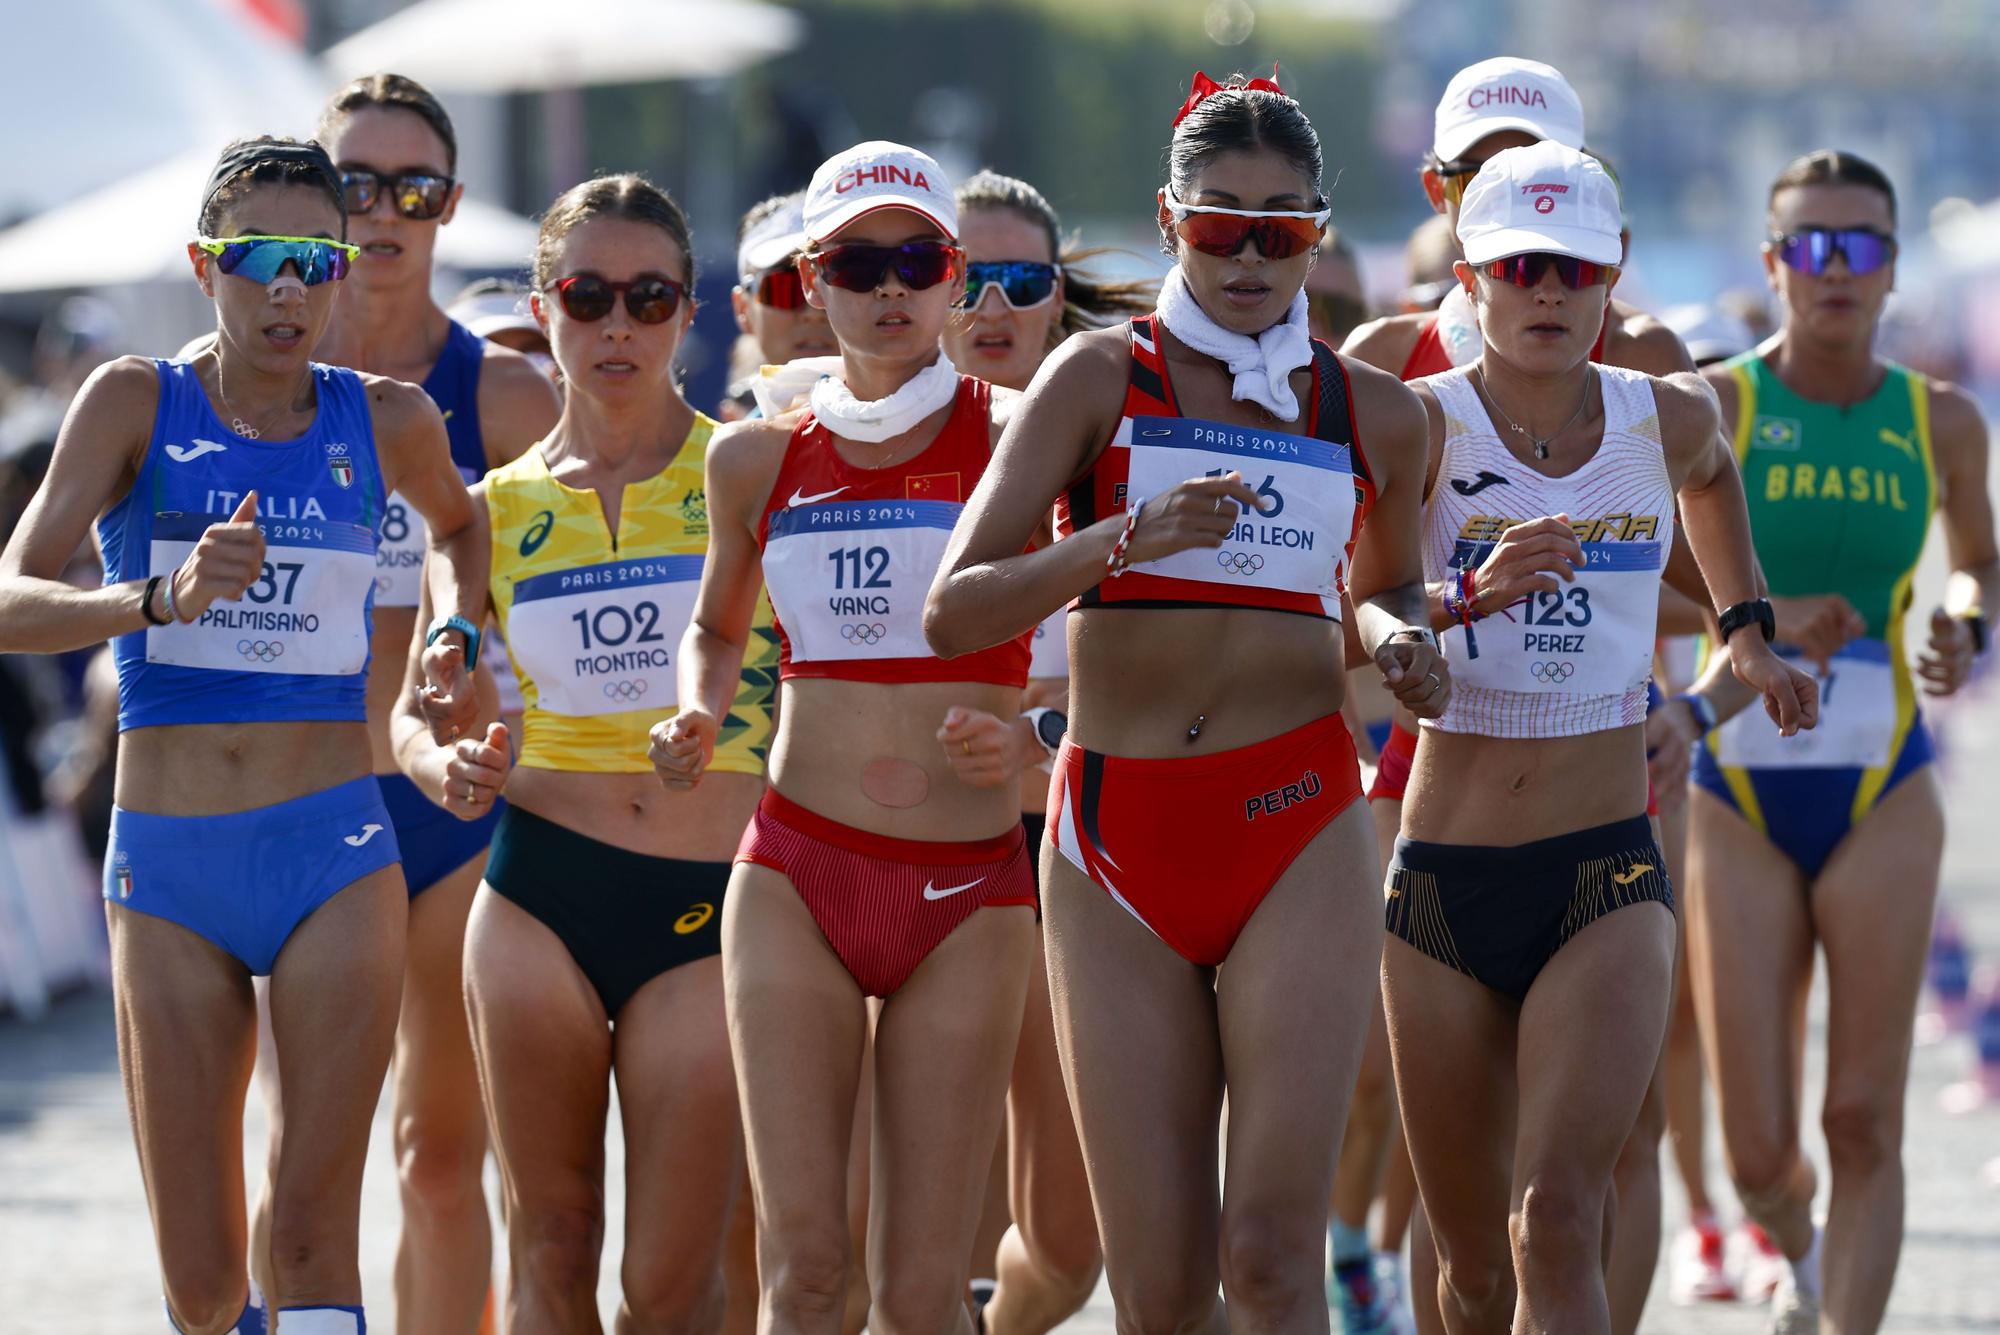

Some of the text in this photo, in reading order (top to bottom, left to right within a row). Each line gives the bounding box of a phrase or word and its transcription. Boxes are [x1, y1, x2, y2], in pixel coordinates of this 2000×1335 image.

[1468, 85, 1547, 109] CHINA
[835, 165, 931, 193] CHINA
[1521, 183, 1569, 195] TEAM
[1194, 428, 1299, 456] PARIS 2024
[1765, 463, 1908, 511] BRASIL
[206, 489, 327, 521] ITLIA
[811, 507, 915, 525] PARIS 2024
[274, 525, 323, 541] 2024
[1260, 525, 1315, 550] LEON
[561, 564, 667, 588] PARIS 2024
[828, 546, 892, 589] 112
[829, 596, 890, 616] YANG
[1524, 587, 1593, 628] 123
[199, 608, 320, 633] PALMISANO
[572, 601, 665, 650] 102
[1524, 632, 1586, 653] PEREZ
[575, 648, 670, 677] MONTAG
[1245, 769, 1322, 821] PERÚ
